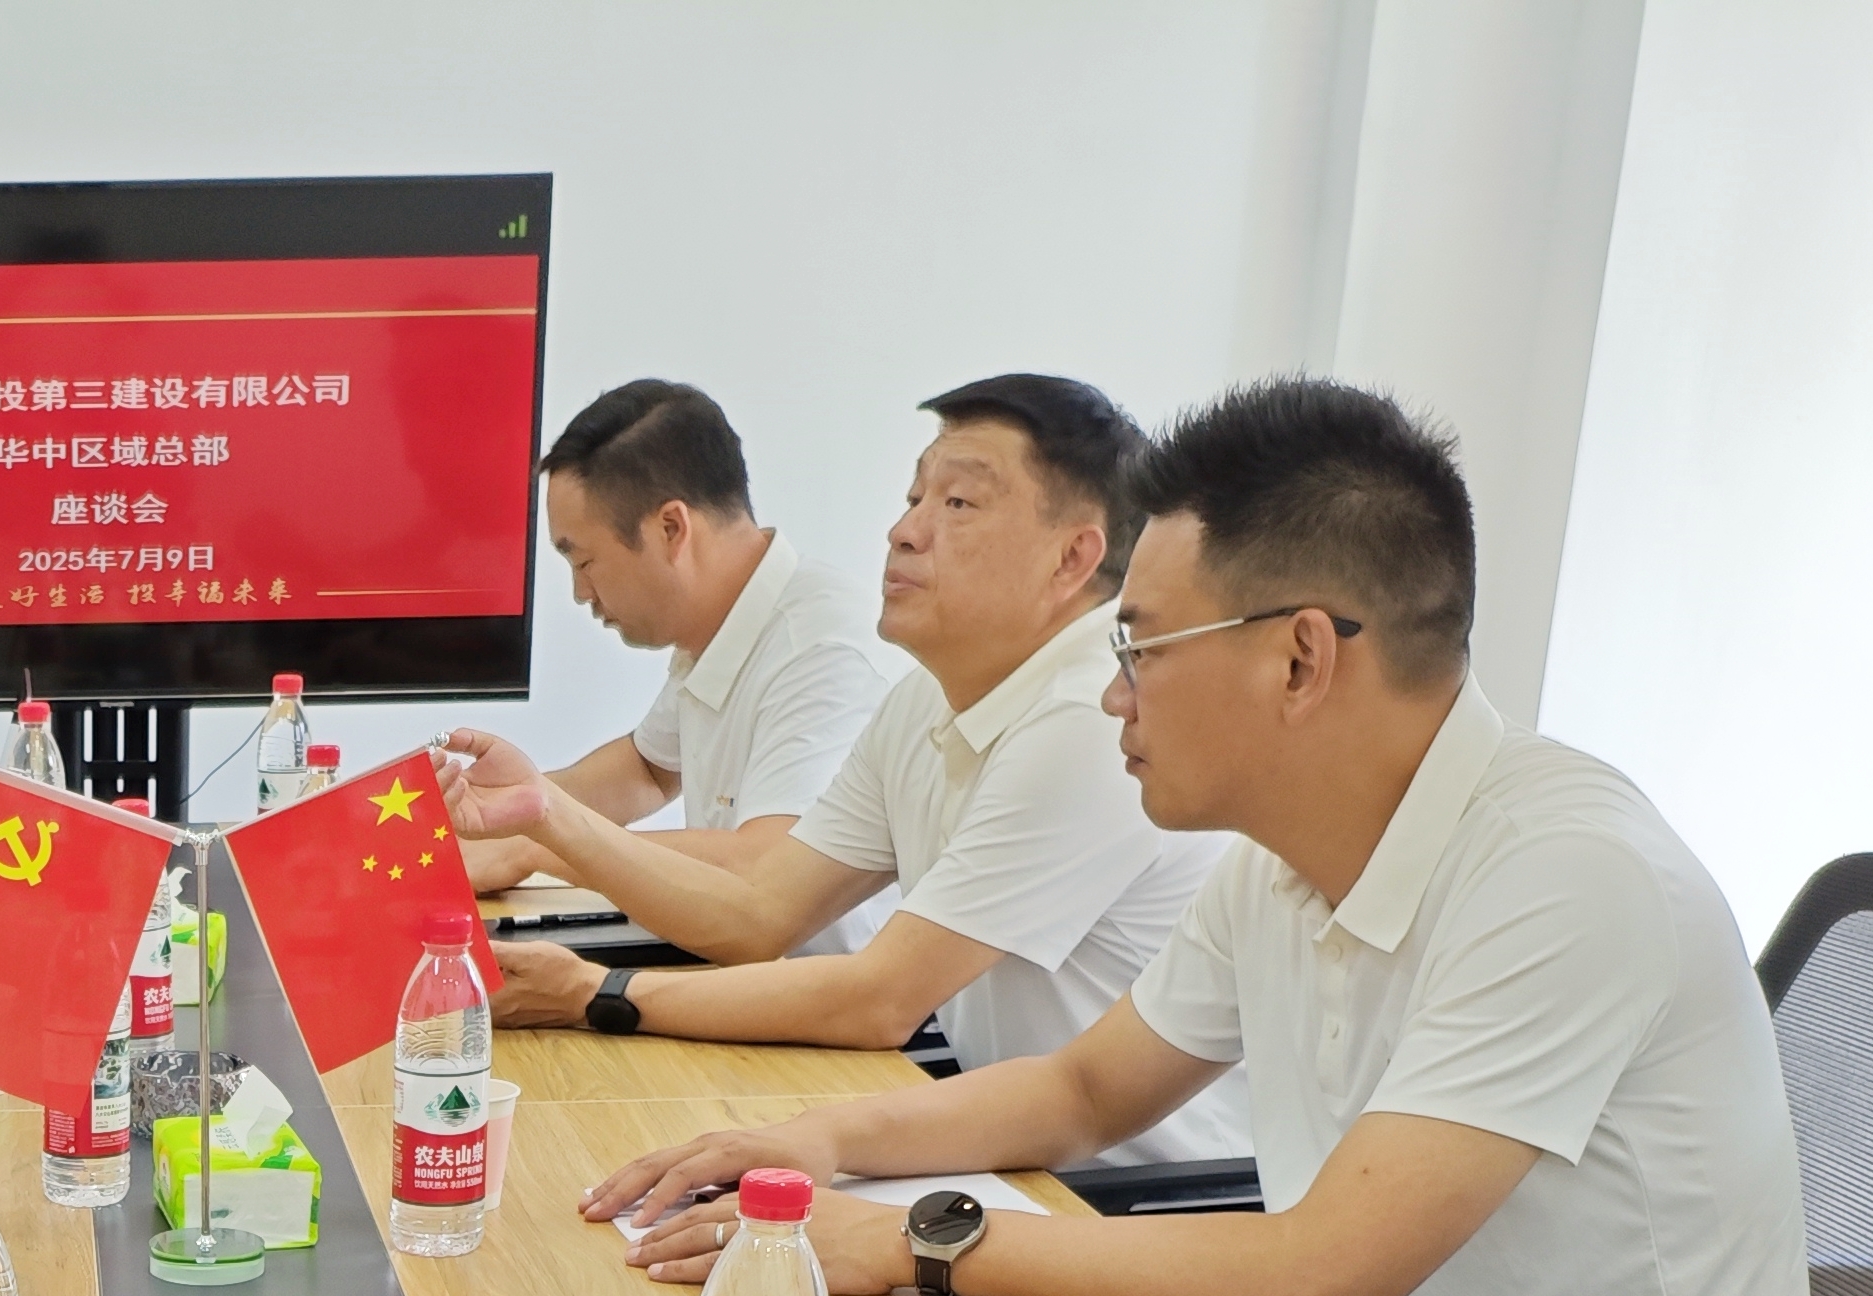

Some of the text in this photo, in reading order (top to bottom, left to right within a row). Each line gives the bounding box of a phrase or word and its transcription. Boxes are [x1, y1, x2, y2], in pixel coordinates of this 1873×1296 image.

[51, 493, 169, 525] 座谈会
[18, 546, 214, 573] 2025年7月9日
[126, 577, 293, 605] 投幸福未来
[144, 986, 173, 1005] 农夫
[414, 1141, 484, 1167] 农夫山泉
[414, 1168, 453, 1179] NONGFU
